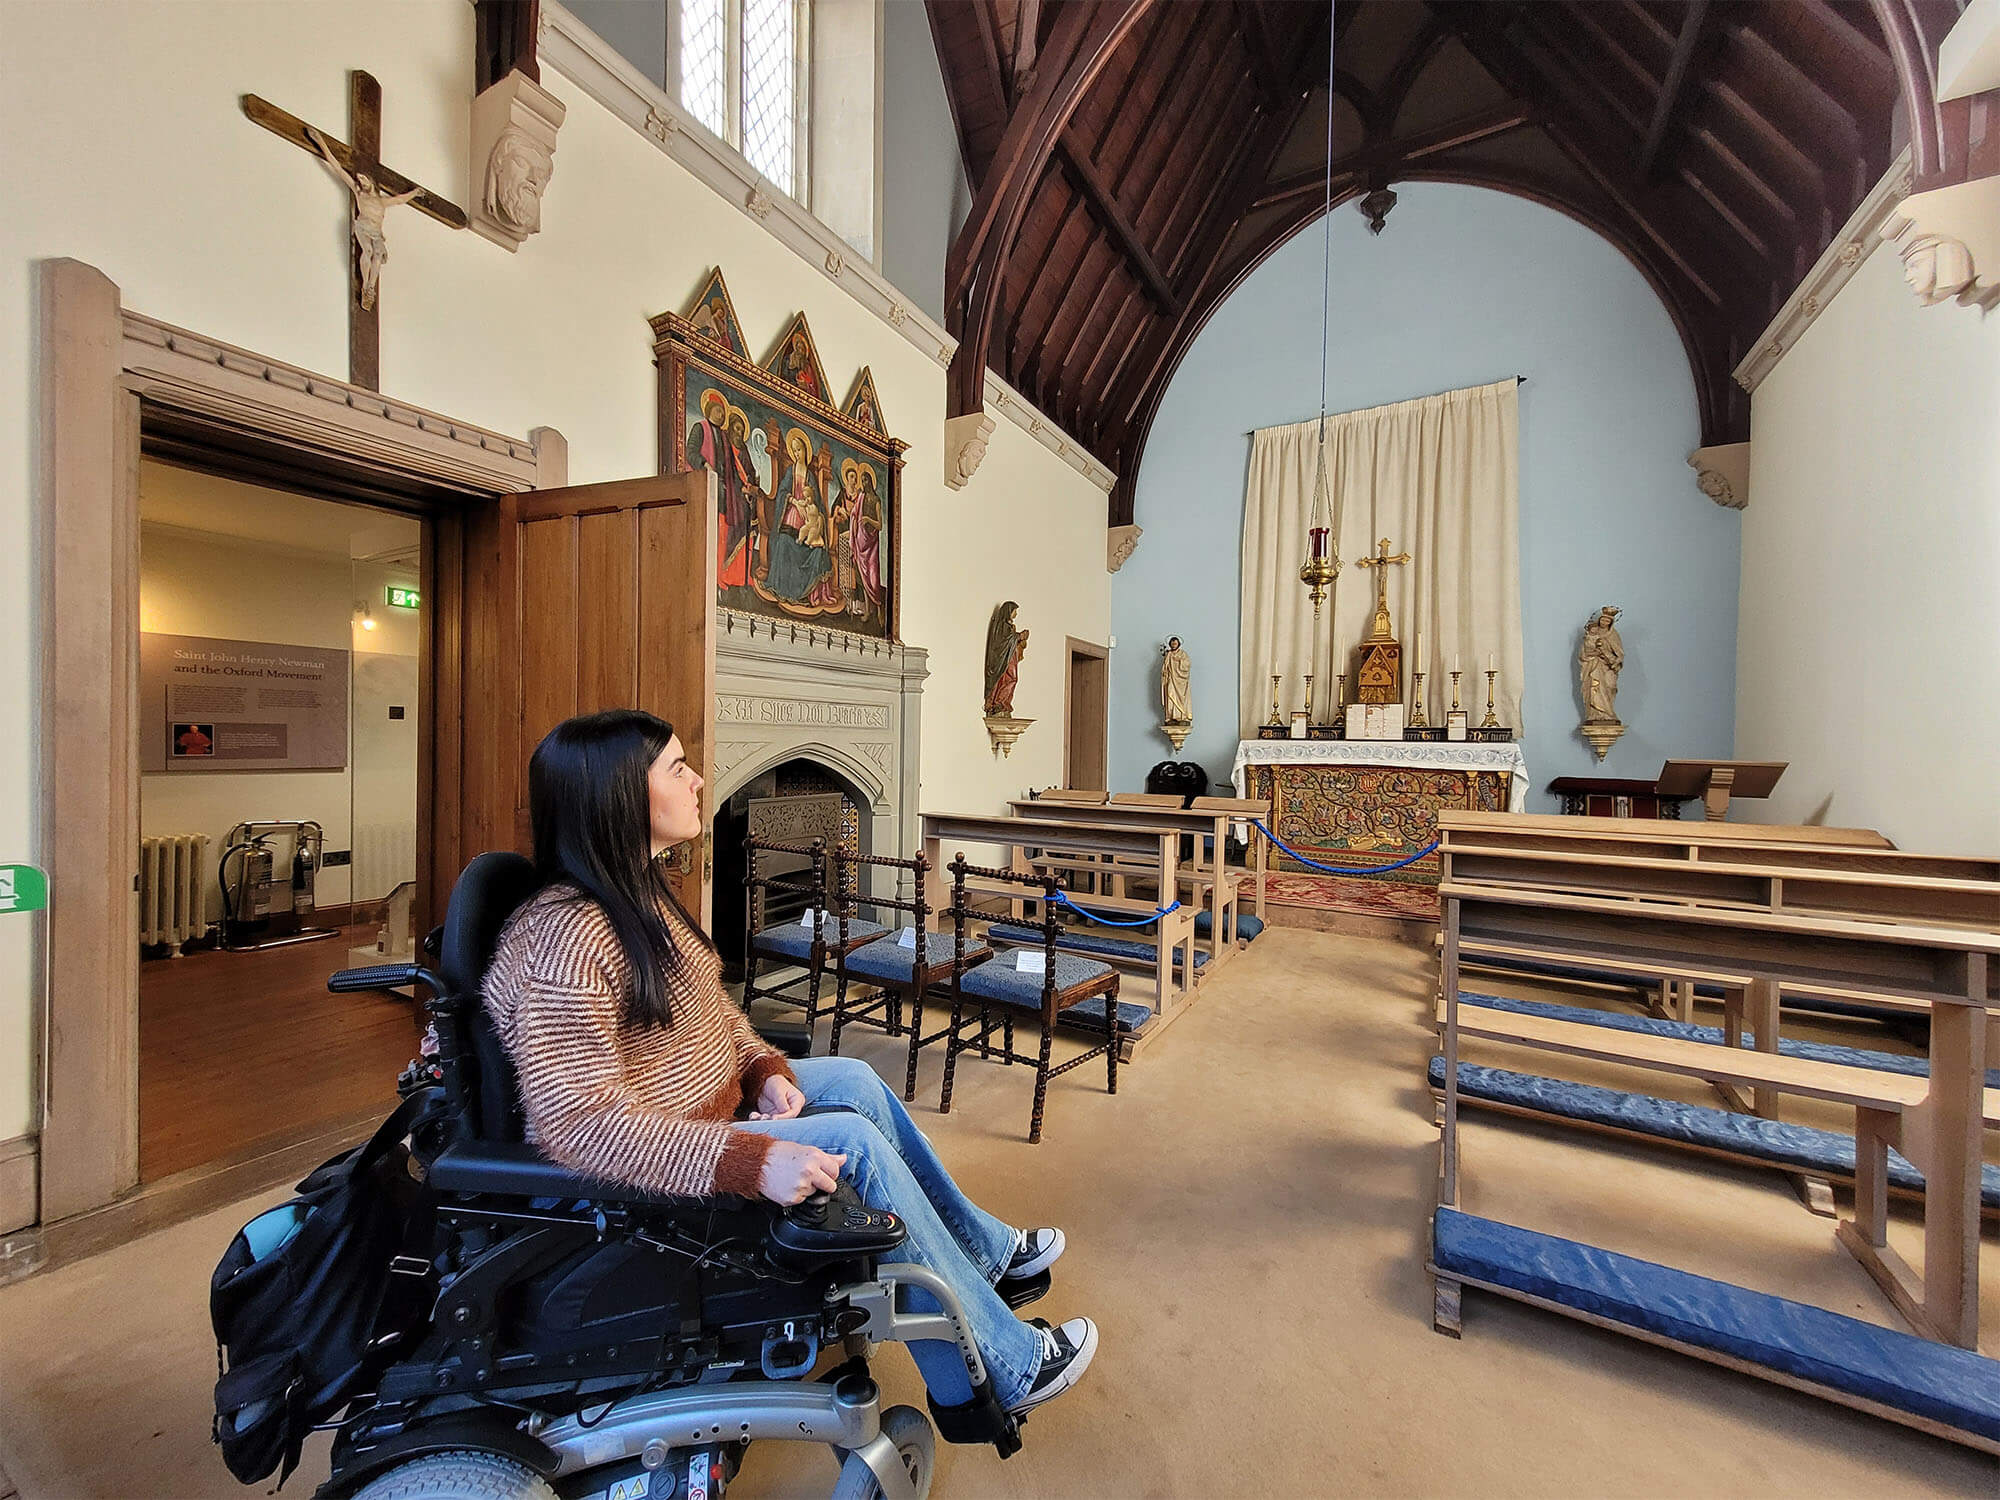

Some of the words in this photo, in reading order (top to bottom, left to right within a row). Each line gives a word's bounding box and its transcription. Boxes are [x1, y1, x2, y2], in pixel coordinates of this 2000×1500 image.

[174, 649, 206, 660] Saint
[210, 652, 237, 663] John
[241, 655, 276, 667] Henry
[278, 657, 325, 669] Newman
[174, 664, 197, 673] and
[200, 664, 221, 676] the
[223, 666, 263, 678] Oxford
[267, 670, 322, 680] Movement
